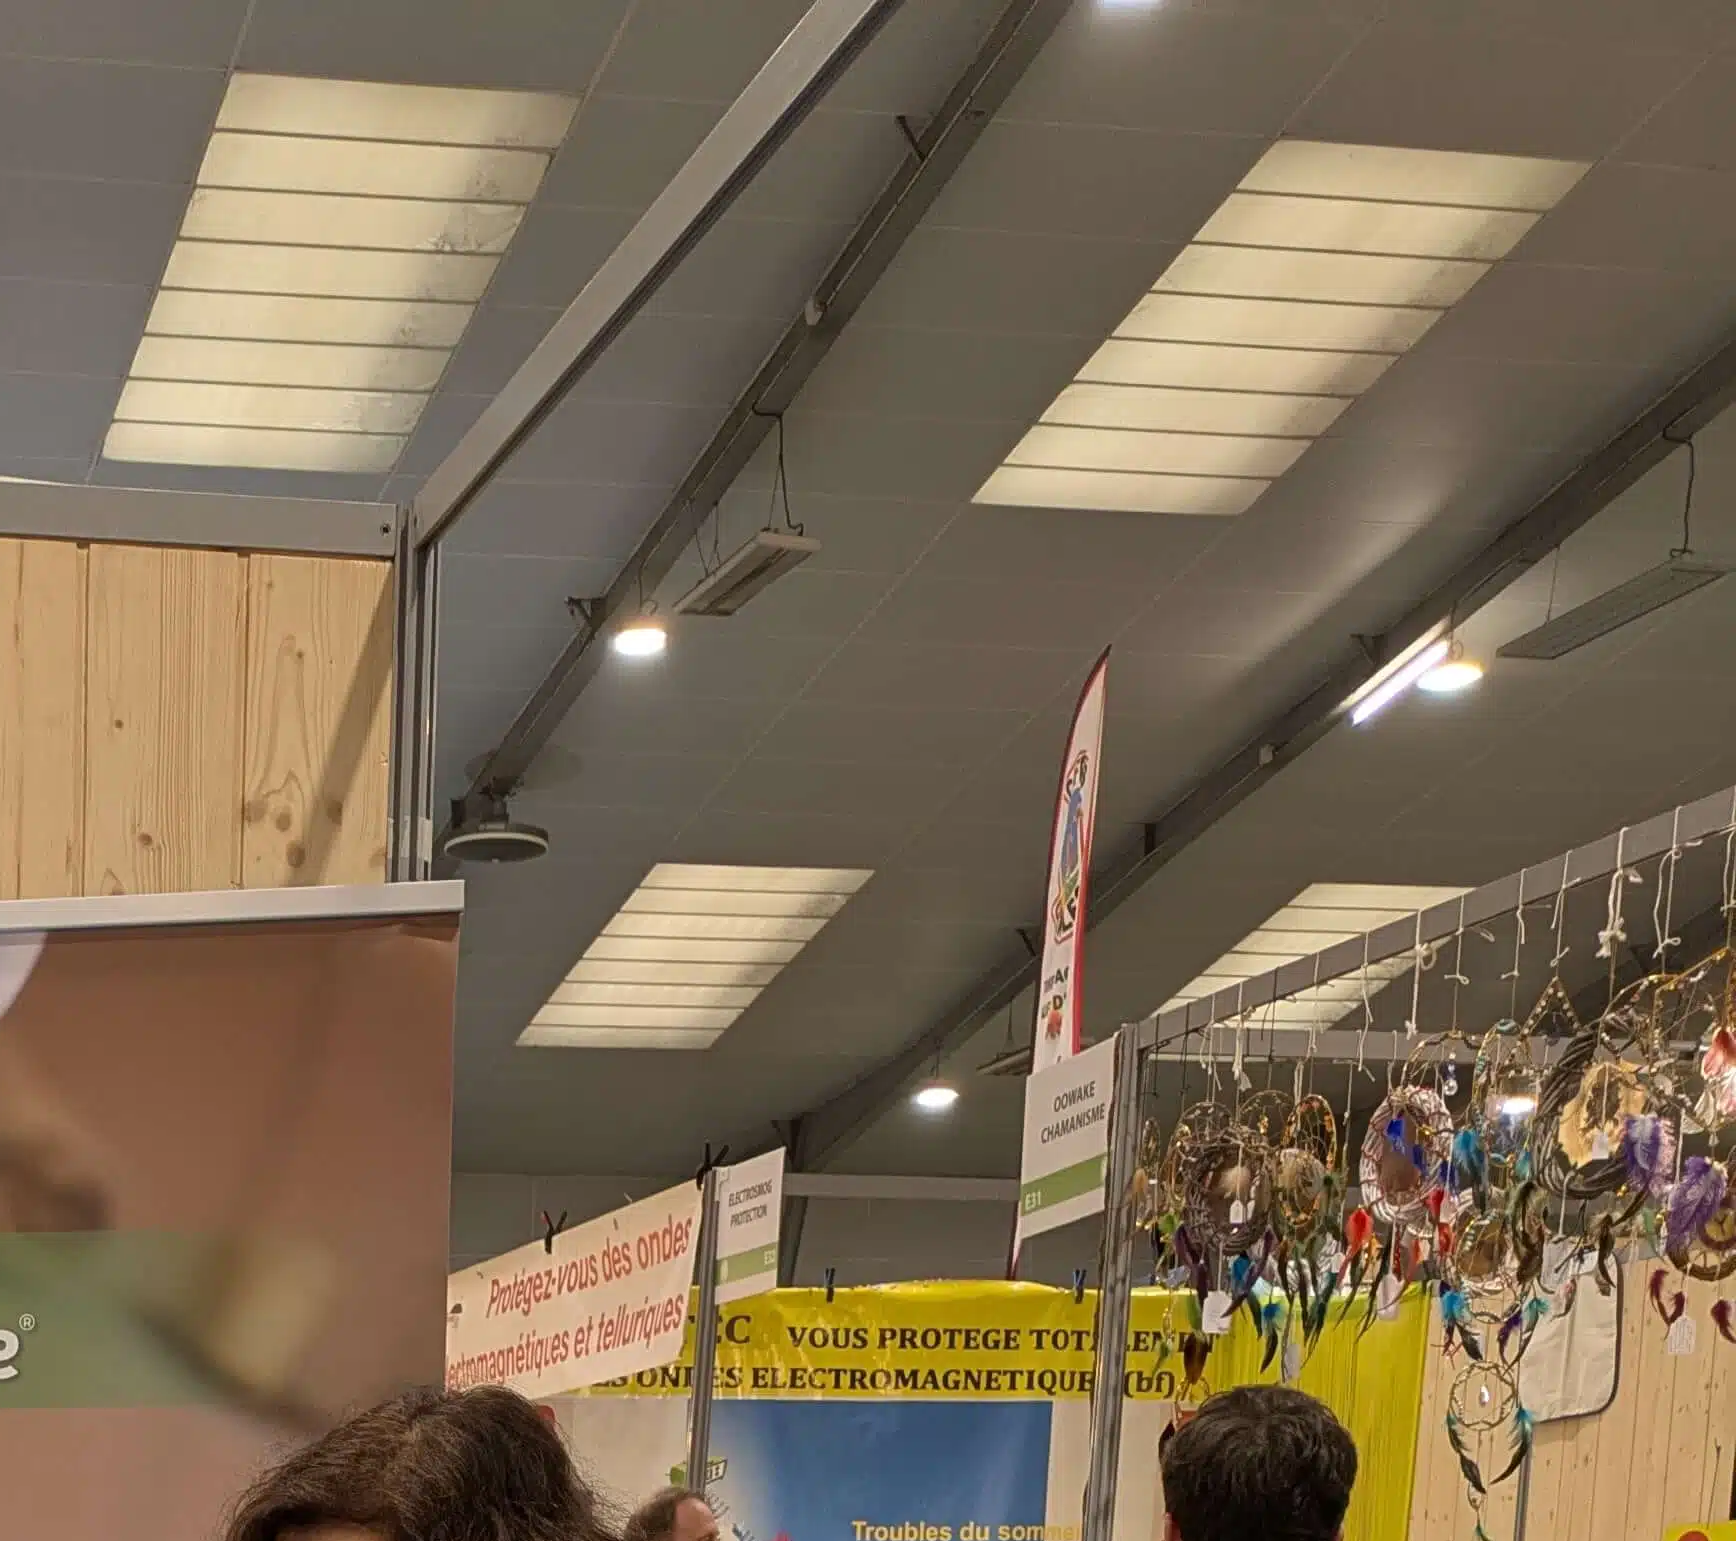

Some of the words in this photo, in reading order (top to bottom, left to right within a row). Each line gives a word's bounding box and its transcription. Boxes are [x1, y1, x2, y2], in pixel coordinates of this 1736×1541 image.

[1054, 1081, 1096, 1112] OOWAKE
[1041, 1104, 1105, 1143] CHAMANISME
[730, 1204, 767, 1228] PROTECTION
[487, 1258, 597, 1318] Protégez-vous
[602, 1239, 632, 1282] des
[637, 1215, 692, 1269] ondes
[574, 1316, 593, 1359] et
[598, 1293, 684, 1352] telluriques
[788, 1327, 868, 1349] VOUS
[878, 1328, 1021, 1351] PROTEGE
[751, 1367, 1095, 1395] ELECTROMAGNETIQUE
[1125, 1370, 1175, 1398] (bf)
[852, 1520, 952, 1541] Troubles
[960, 1521, 990, 1541] du
